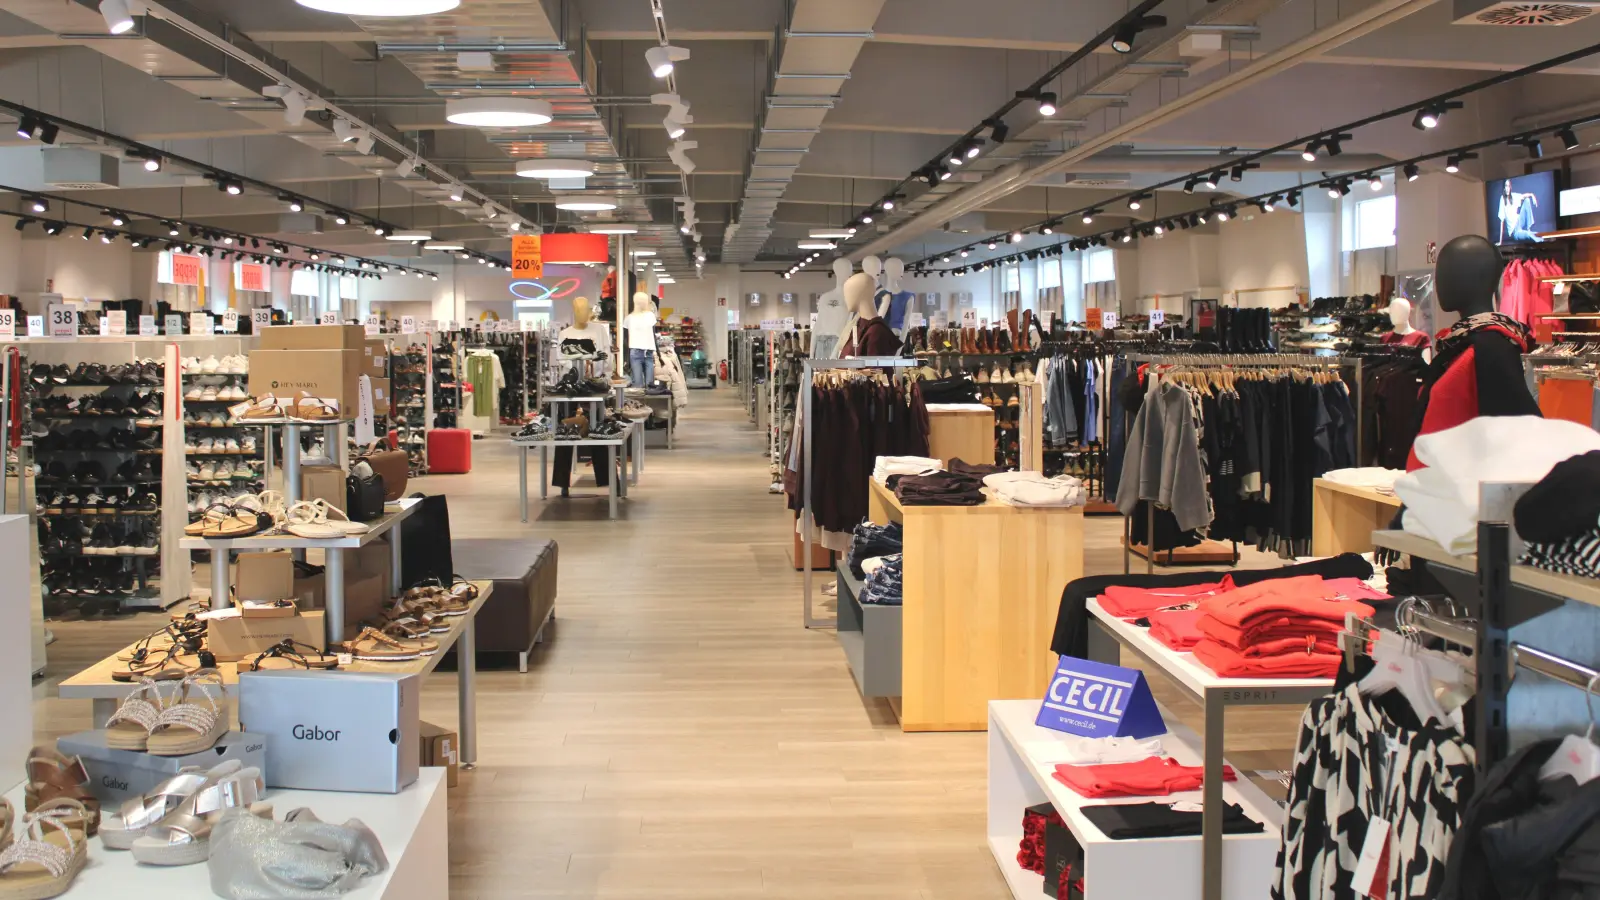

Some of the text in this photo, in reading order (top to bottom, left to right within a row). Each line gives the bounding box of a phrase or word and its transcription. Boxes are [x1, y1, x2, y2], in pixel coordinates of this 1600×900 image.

[515, 259, 540, 271] 20%
[53, 310, 73, 324] 38
[224, 313, 237, 321] 40
[255, 313, 269, 322] 39
[323, 314, 335, 324] 39
[963, 311, 975, 320] 41
[1151, 313, 1162, 321] 41
[30, 319, 41, 327] 40
[367, 317, 378, 325] 40
[1049, 676, 1123, 716] CECIL
[1223, 690, 1278, 701] ESPRIT
[1059, 715, 1097, 730] www.cecil.de
[292, 724, 342, 741] Gabor
[245, 743, 263, 753] Gabor
[102, 775, 129, 791] Gabor
